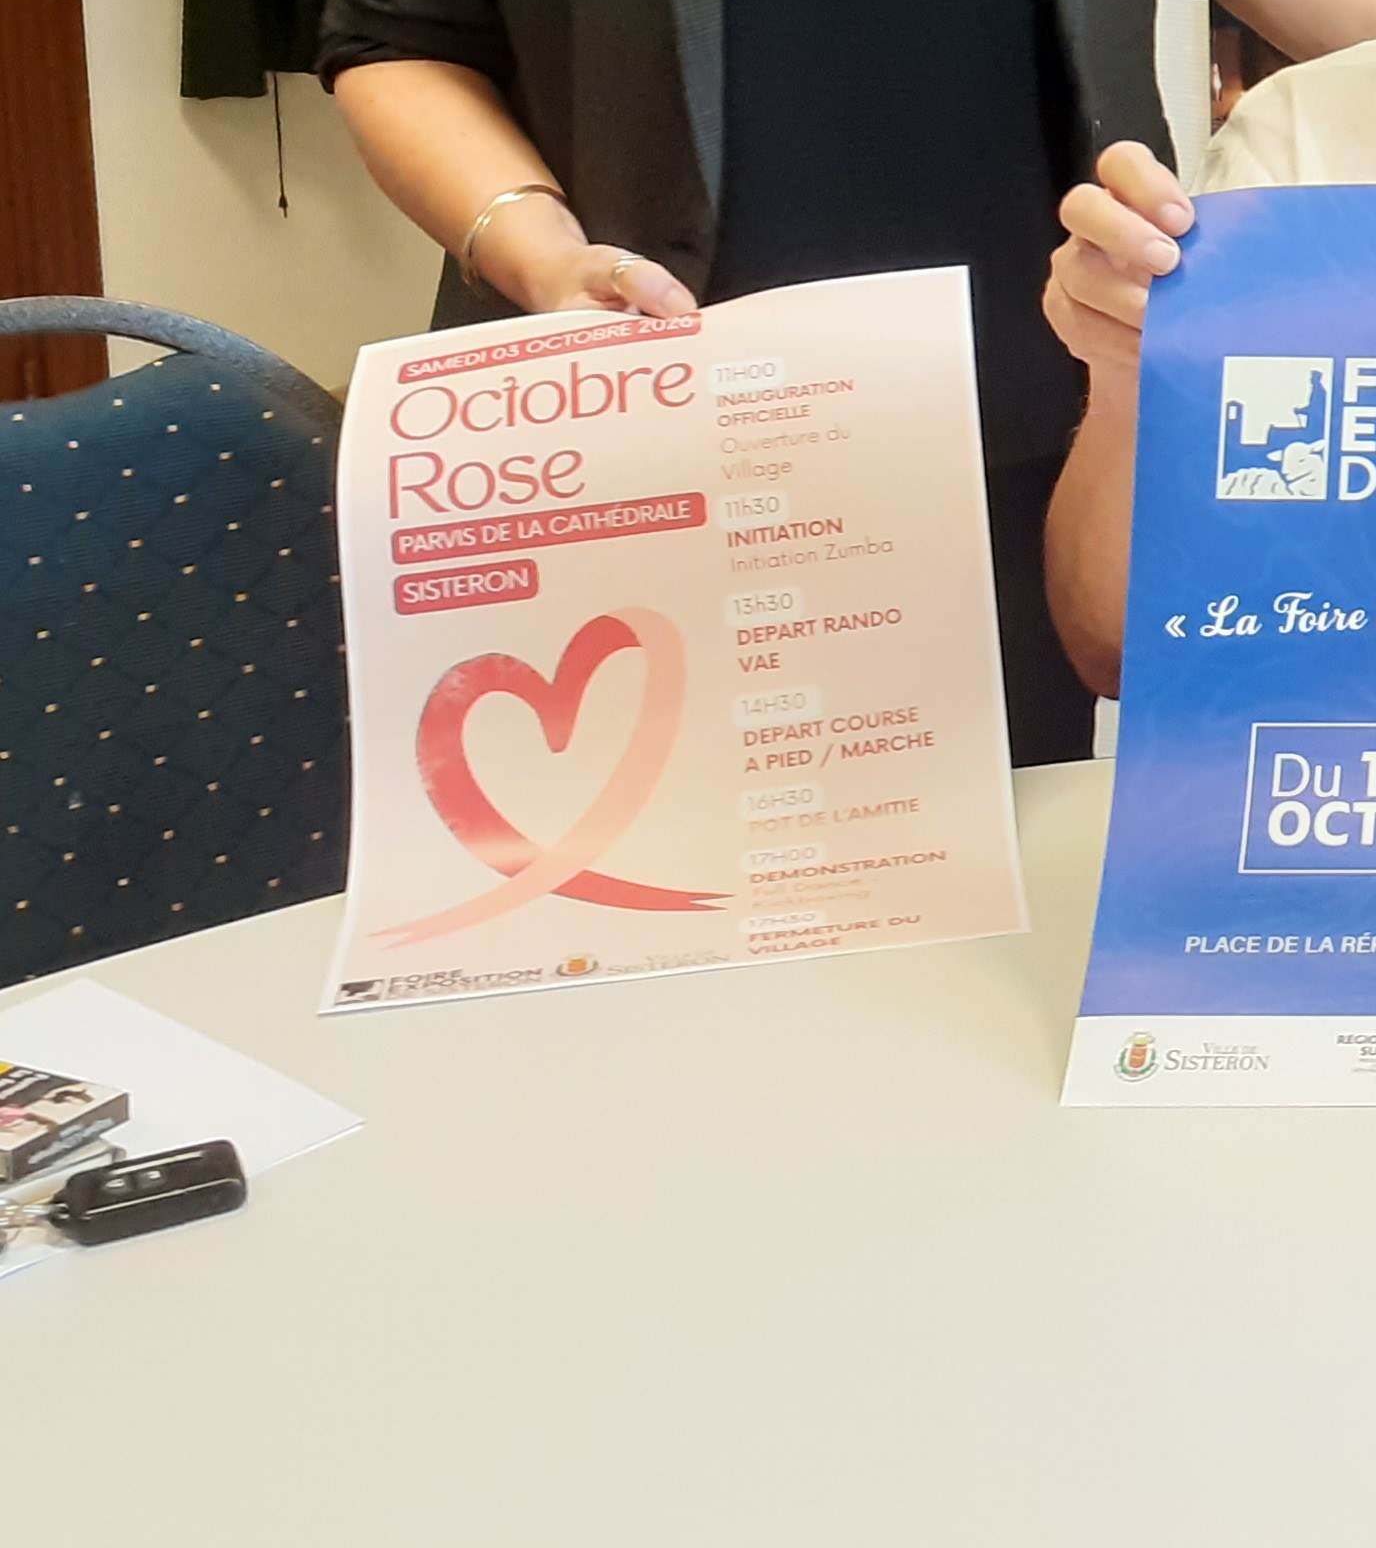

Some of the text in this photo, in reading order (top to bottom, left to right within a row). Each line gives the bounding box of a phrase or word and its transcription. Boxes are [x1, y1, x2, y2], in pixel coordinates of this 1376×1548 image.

[406, 316, 693, 378] SAMEDI 03 OCTOBRE 2026
[716, 362, 776, 382] 11H00
[390, 361, 696, 440] Octobre
[717, 379, 854, 407] INAUGURATION
[717, 405, 811, 427] OFFICIELLE
[720, 422, 851, 454] Ouverture du
[721, 459, 793, 481] Village
[390, 450, 585, 519] Rose
[725, 496, 780, 518] 11h30
[399, 500, 691, 554] PARVIS DE LA CATHÉDRALE
[727, 518, 843, 548] INITIATION
[730, 536, 893, 572] Initiation Zumba
[403, 568, 529, 603] SISTERON
[734, 593, 793, 615] 13h30
[1199, 595, 1262, 636] La
[1273, 592, 1368, 633] Foire
[737, 608, 902, 646] DEPART RANDO
[738, 652, 780, 673] VAE
[742, 692, 806, 715] 14H30
[744, 706, 919, 747] DEPART COURSE
[744, 756, 760, 773] A
[766, 750, 813, 770] PIED
[840, 731, 935, 759] MARCHE
[1271, 752, 1341, 797] Du
[748, 788, 814, 811] 16H30
[750, 798, 920, 834] POT DE L'AMITIE
[750, 847, 817, 865] 17H00
[750, 851, 947, 884] DEMONSTRATION
[749, 913, 816, 927] 17H30
[749, 915, 921, 942] FERMETURE DU
[749, 937, 841, 955] VILLAGE
[1185, 936, 1261, 953] PLACE
[1266, 936, 1299, 953] DE
[1305, 936, 1335, 953] LA
[390, 968, 464, 983] FOIRE
[1163, 1050, 1270, 1071] SISTERON
